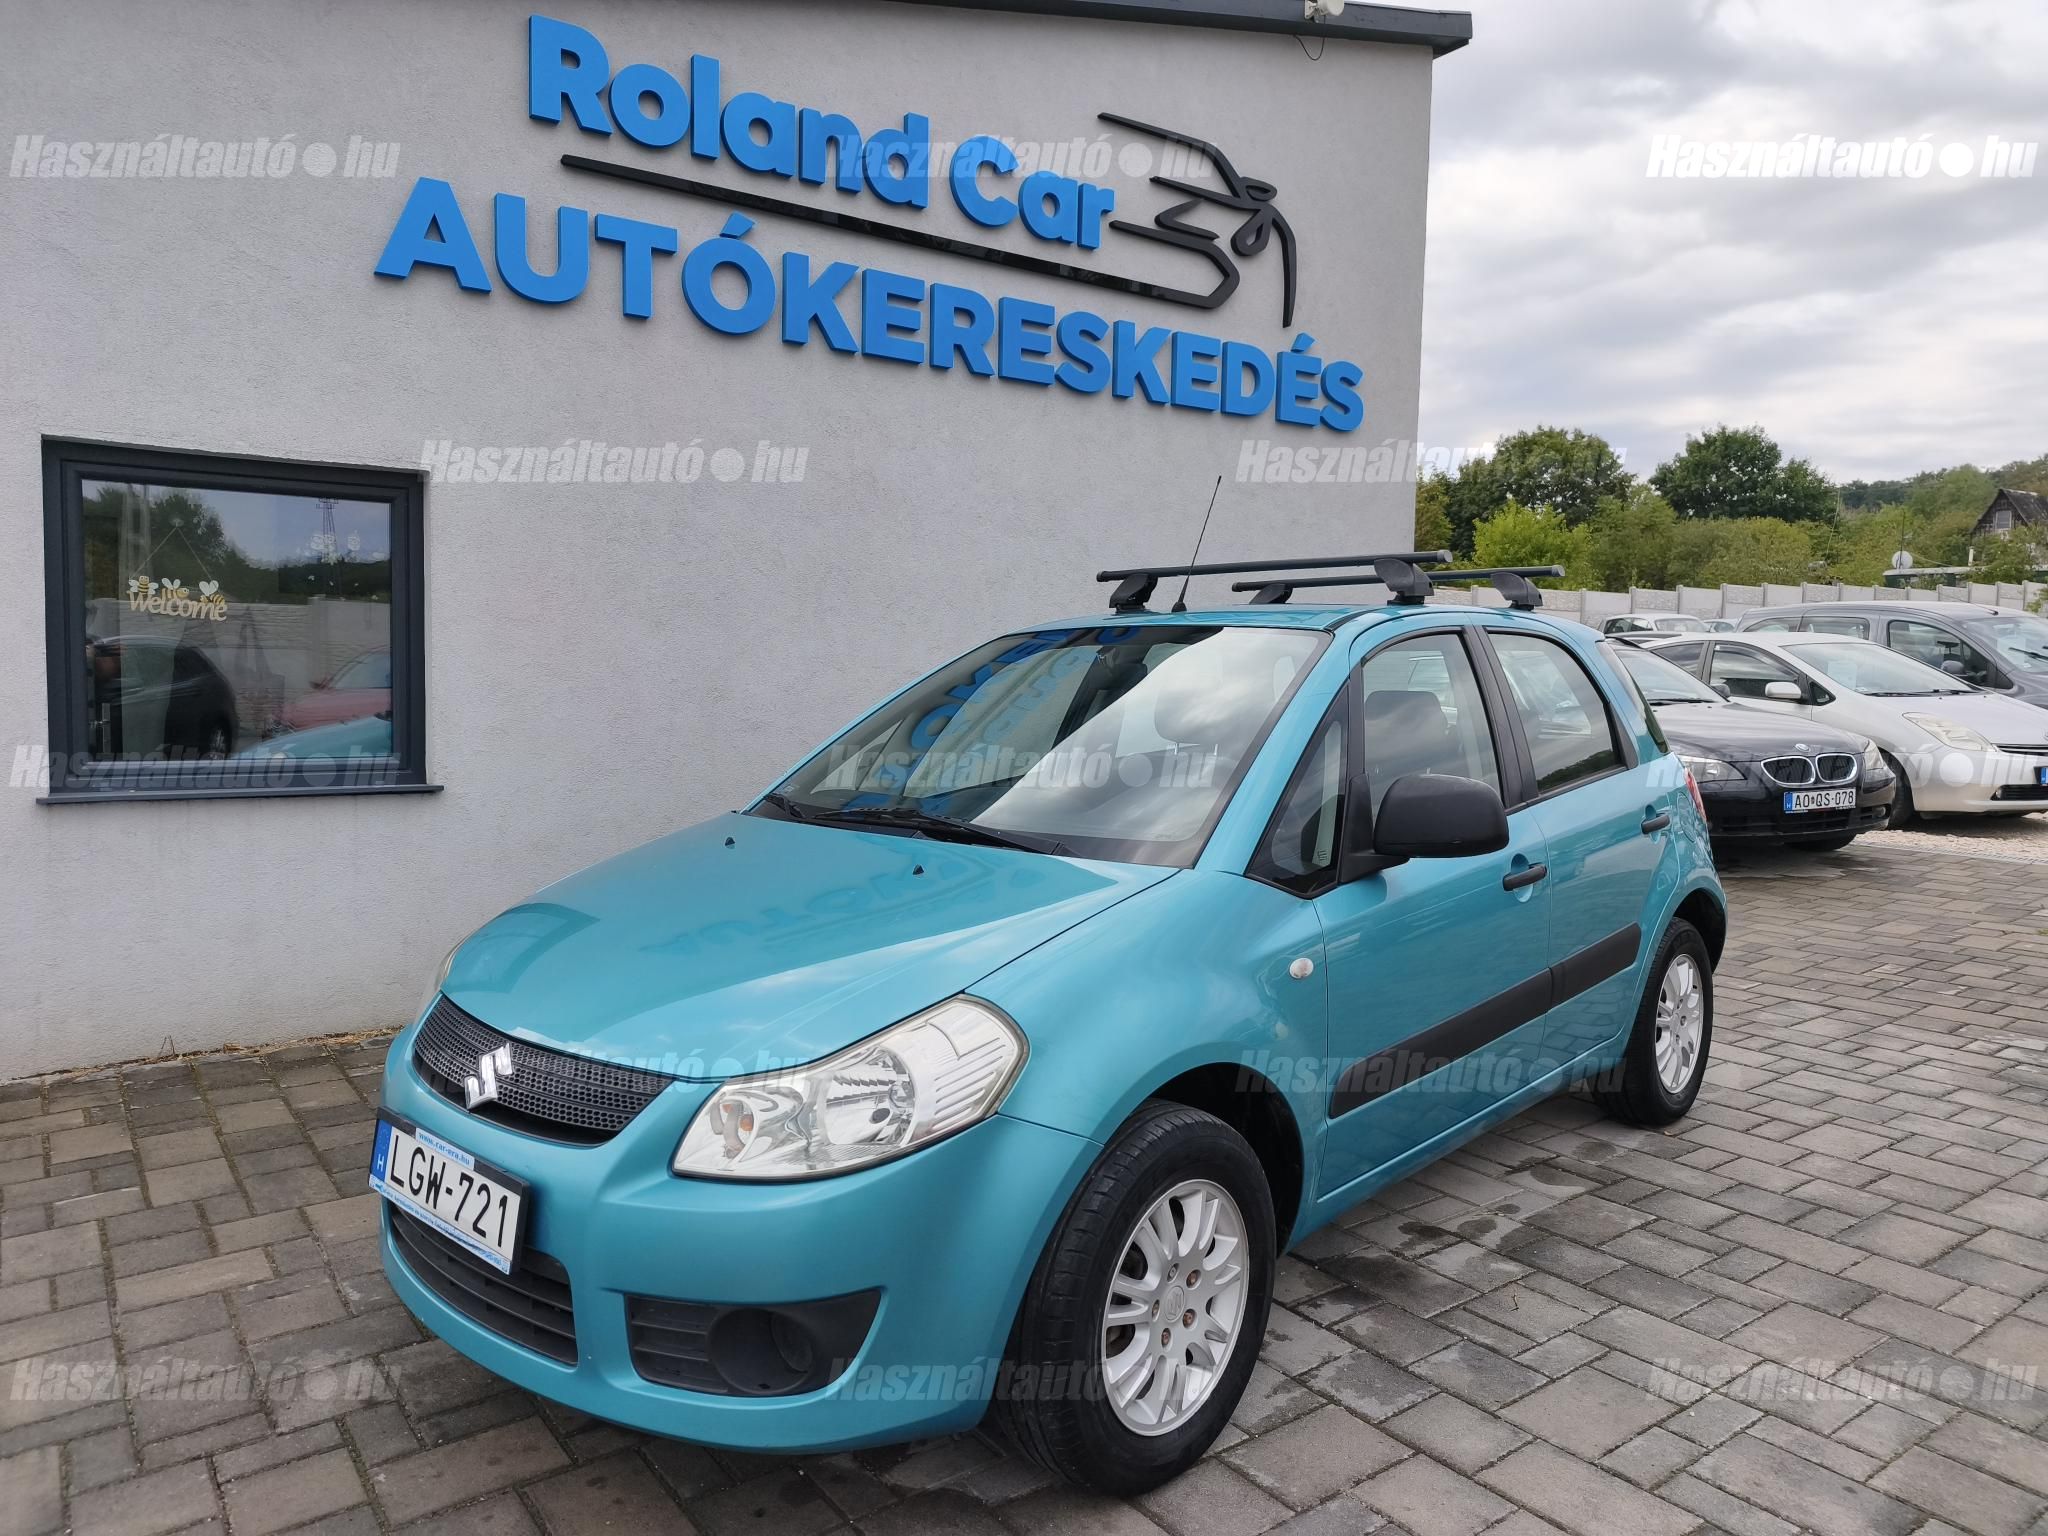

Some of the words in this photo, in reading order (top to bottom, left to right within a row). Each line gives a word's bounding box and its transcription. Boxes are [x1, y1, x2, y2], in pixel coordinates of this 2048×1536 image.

[529, 16, 929, 209] Roland
[951, 136, 1115, 249] Car
[374, 178, 1364, 431] AUTÓKERESKEDÉS
[126, 590, 228, 621] Welcome
[390, 1134, 508, 1248] LGW-721
